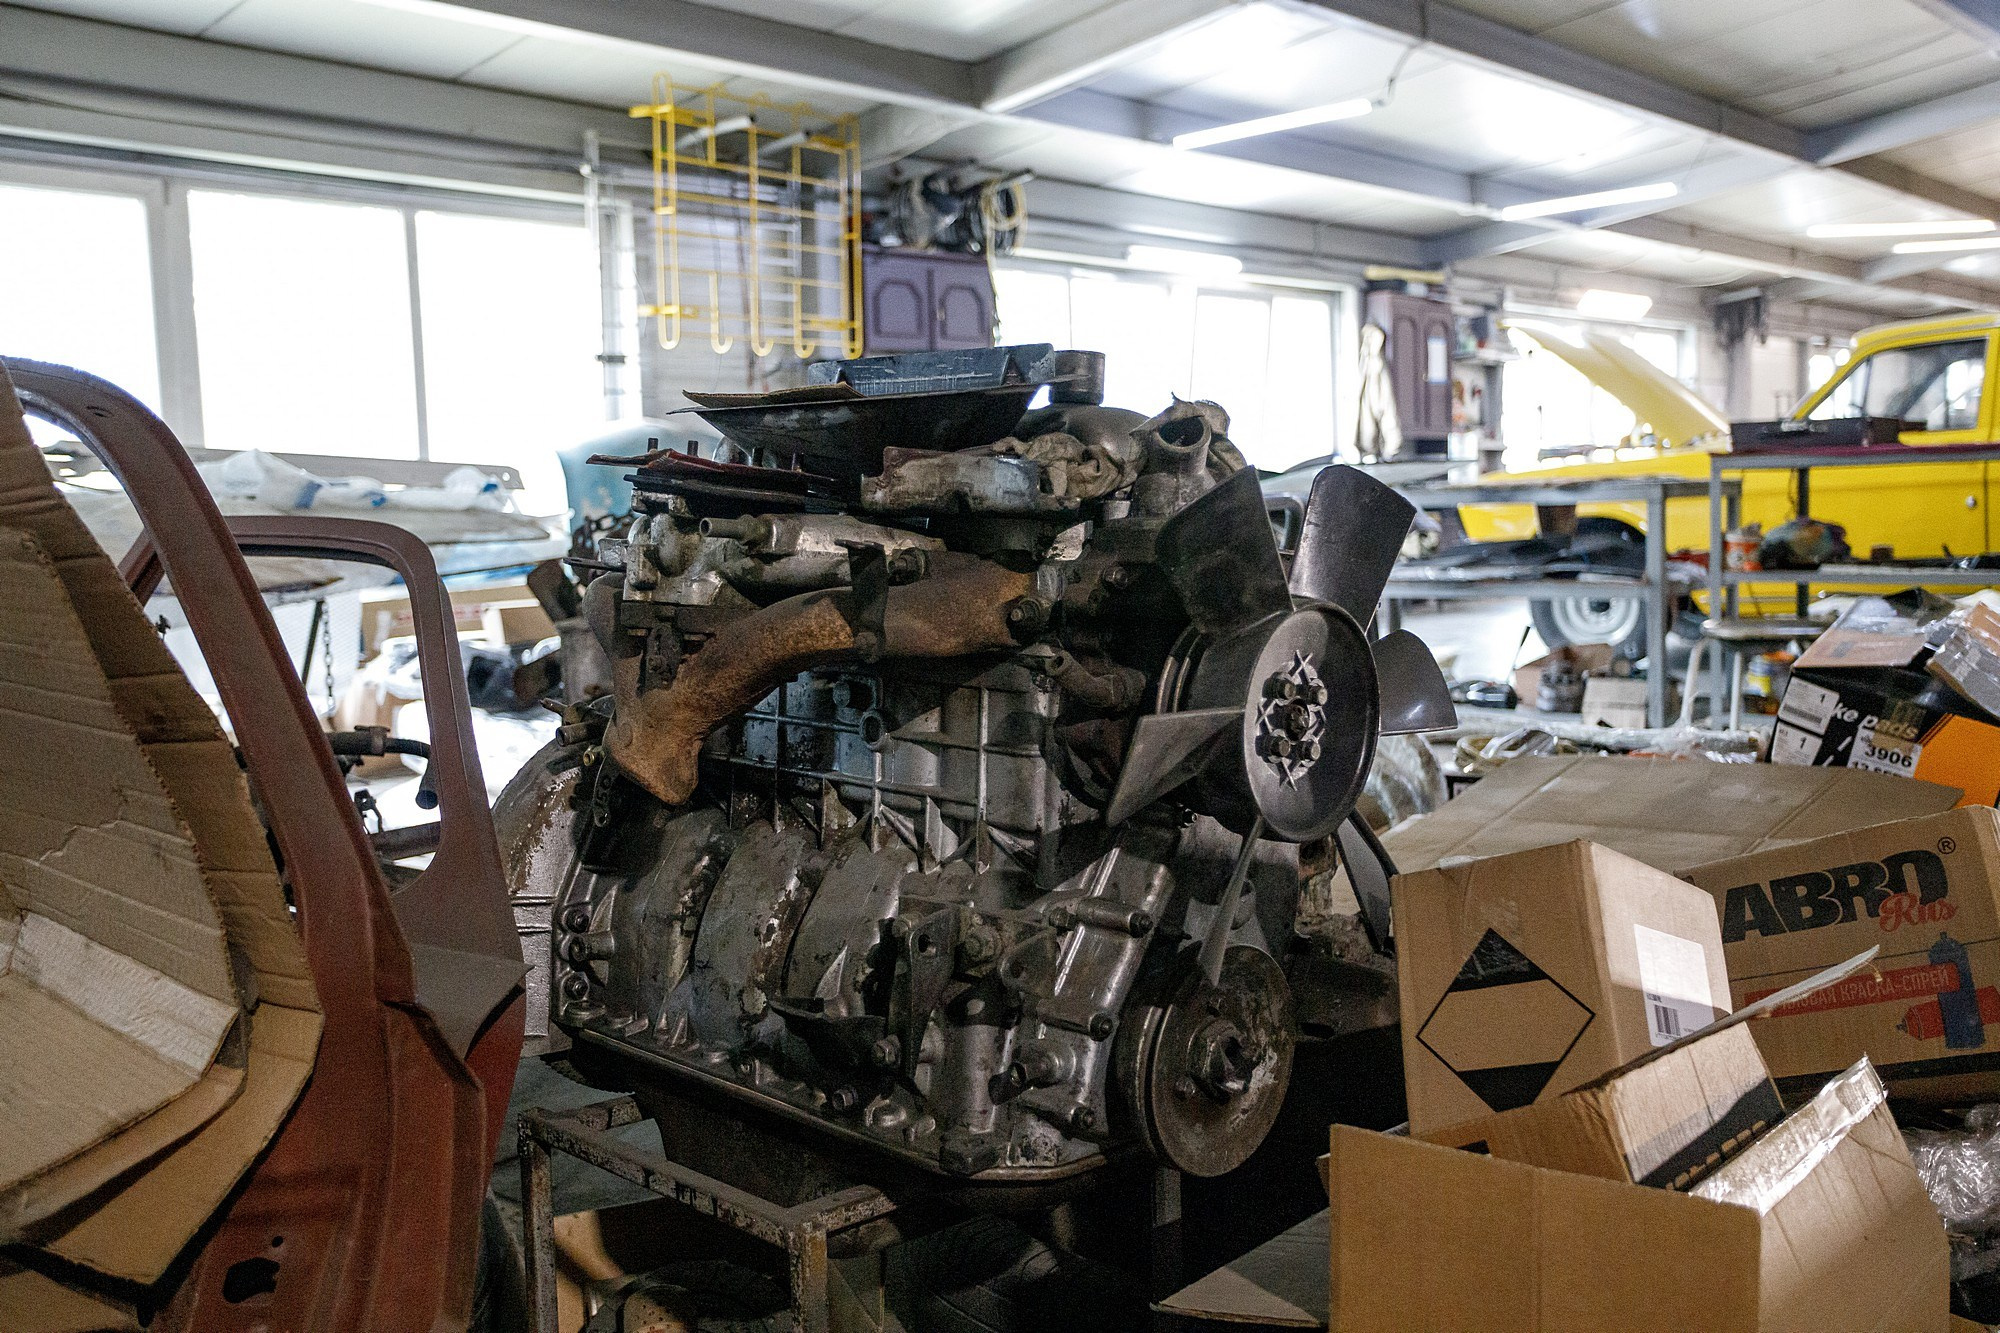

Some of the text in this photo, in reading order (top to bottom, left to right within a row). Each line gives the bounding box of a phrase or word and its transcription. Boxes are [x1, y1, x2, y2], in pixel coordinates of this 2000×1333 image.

[1858, 715, 1919, 739] pads
[1865, 746, 1913, 768] 3906
[1722, 849, 1949, 944] ABRO
[1879, 892, 1959, 932] Rus
[1841, 966, 1950, 1001] КРАСКА-СПРЕЙ
